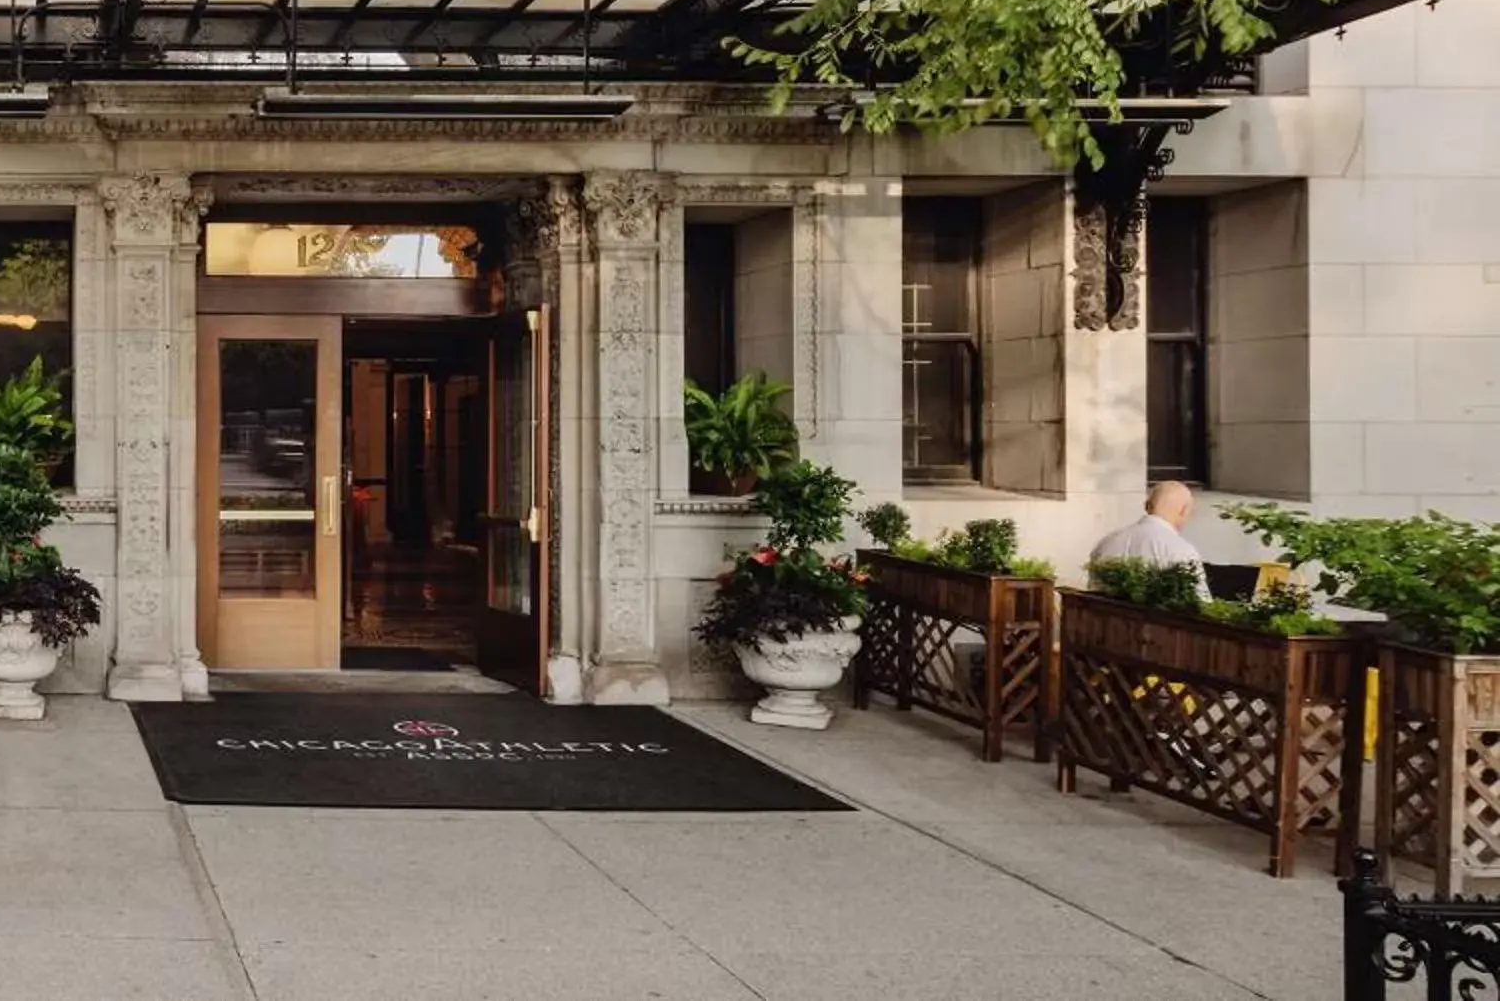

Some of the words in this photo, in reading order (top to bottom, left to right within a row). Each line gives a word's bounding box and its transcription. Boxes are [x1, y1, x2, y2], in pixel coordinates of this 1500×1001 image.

[297, 233, 335, 268] 12
[216, 739, 427, 751] CHICAGO
[434, 737, 668, 753] ATHLETIC
